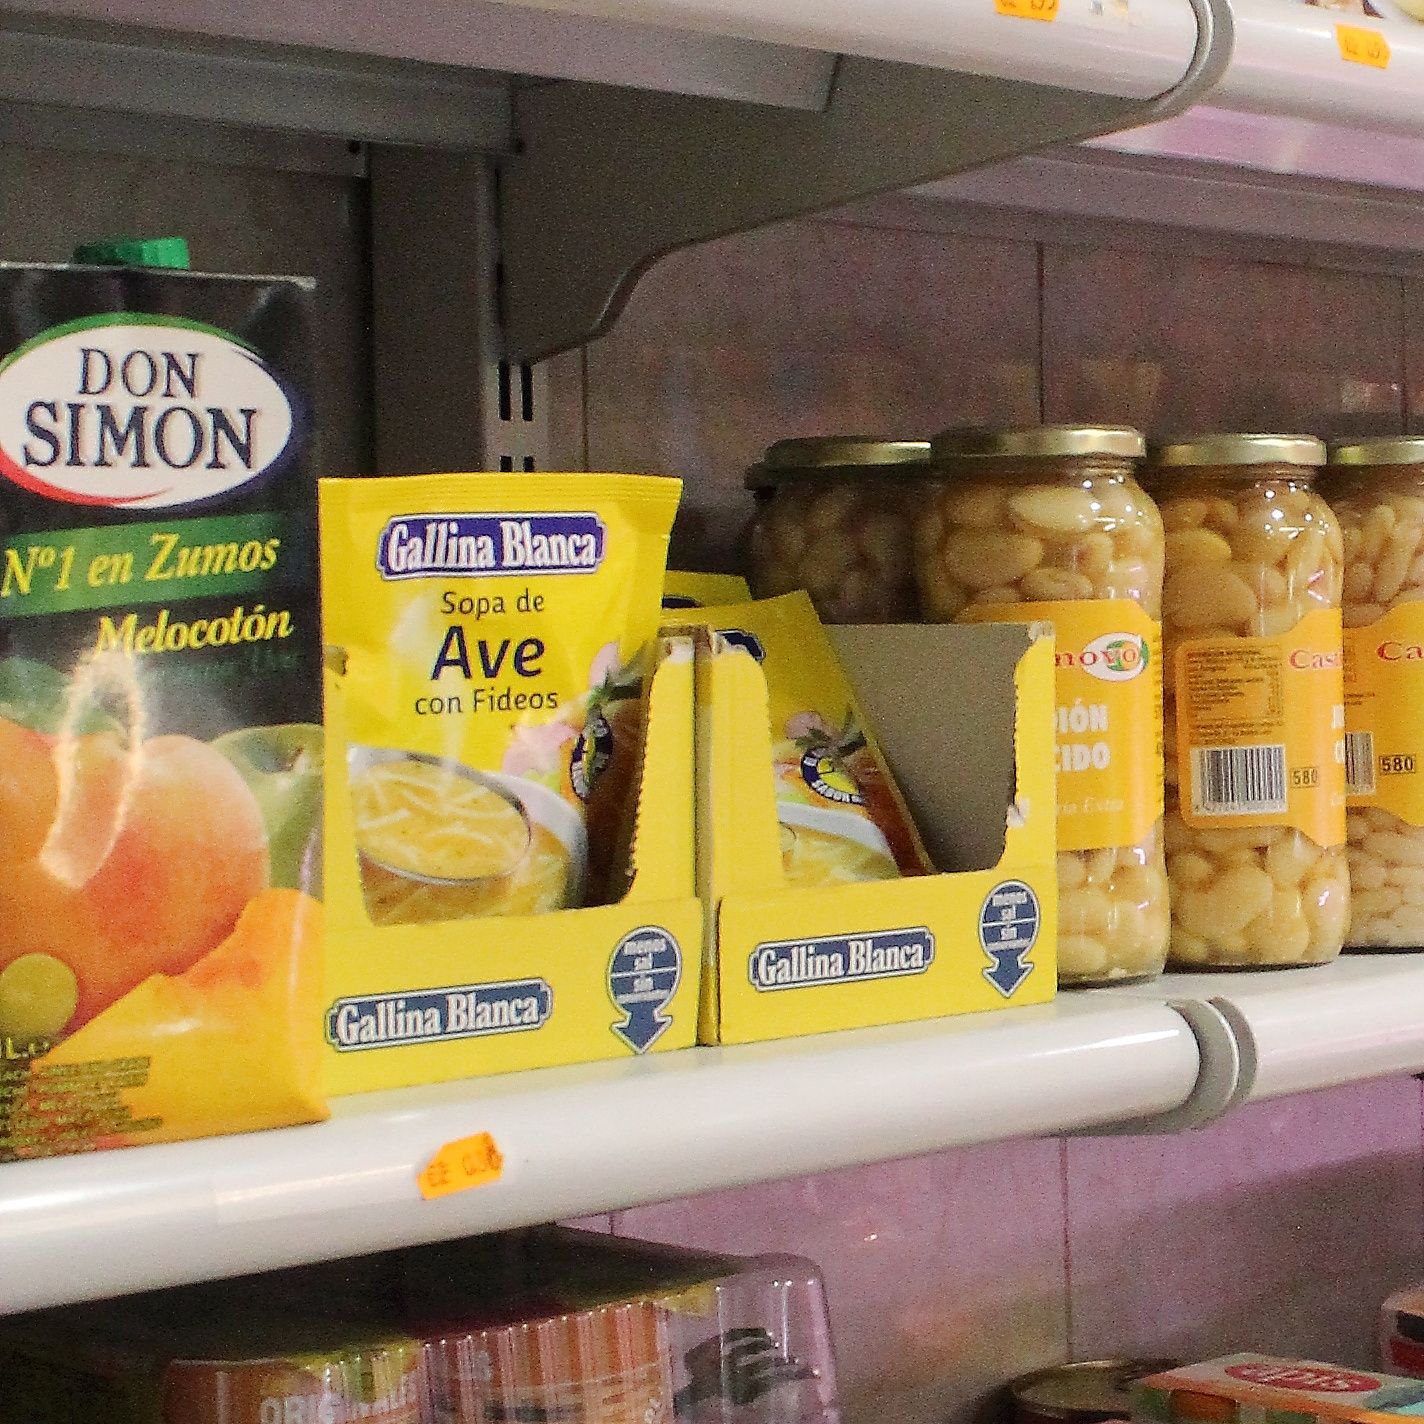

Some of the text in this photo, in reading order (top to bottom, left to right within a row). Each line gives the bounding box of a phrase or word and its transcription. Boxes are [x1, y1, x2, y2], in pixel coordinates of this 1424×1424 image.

[79, 347, 204, 398] DON
[23, 400, 257, 470] SIMON
[89, 547, 133, 582] en
[145, 532, 280, 582] Zumos
[387, 521, 597, 572] Gallina Blanca
[441, 591, 545, 616] Sopa de
[96, 605, 294, 658] Melocotón
[430, 624, 546, 681] Ave
[414, 686, 559, 715] con Fideos
[1381, 757, 1414, 773] 580
[758, 939, 926, 984] Gallina Blanca
[336, 992, 540, 1046] Gallina Blanca
